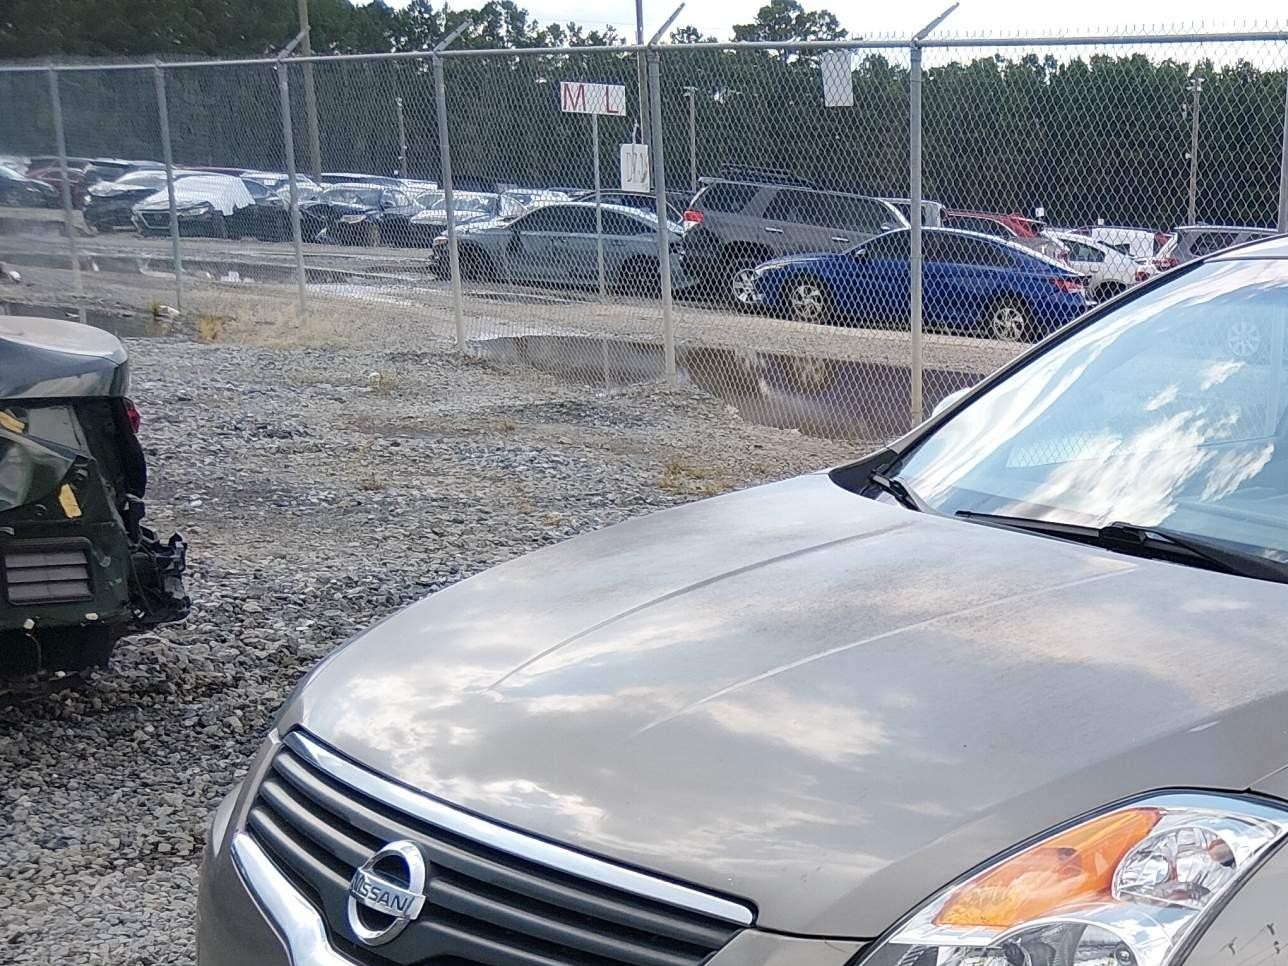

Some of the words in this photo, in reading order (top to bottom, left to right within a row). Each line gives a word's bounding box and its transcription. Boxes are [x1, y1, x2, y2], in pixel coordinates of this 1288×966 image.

[563, 84, 586, 111] M
[605, 86, 620, 113] L
[351, 871, 409, 912] NISSAN
